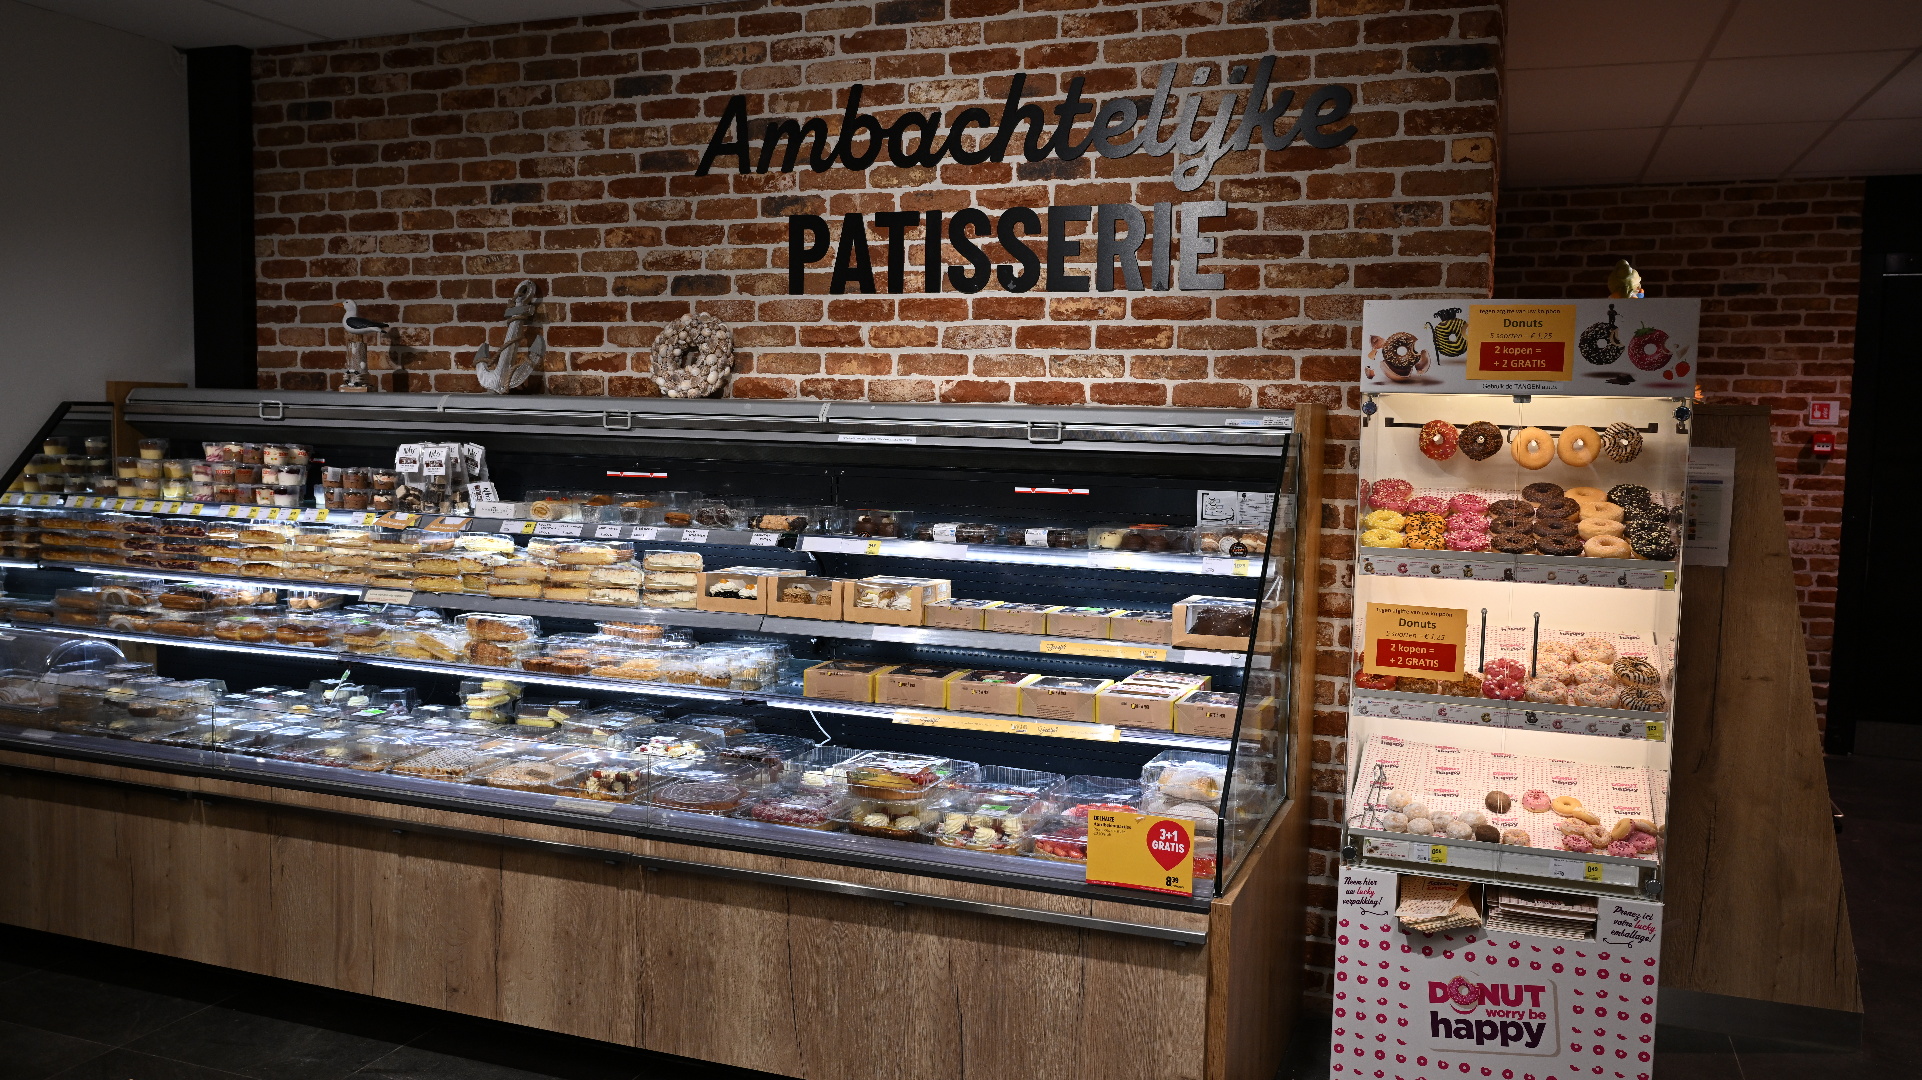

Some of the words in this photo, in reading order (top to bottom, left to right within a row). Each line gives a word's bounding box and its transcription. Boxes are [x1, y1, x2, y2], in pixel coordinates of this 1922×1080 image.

[695, 55, 1357, 193] Ambachtelijke
[788, 201, 1228, 295] PATISSERIE
[1503, 318, 1543, 328] Donuts
[1494, 345, 1501, 354] 2
[1503, 345, 1533, 356] kopen
[1502, 359, 1508, 368] 2
[1510, 359, 1546, 368] GRATIS
[1398, 617, 1437, 629] Donuts
[1390, 644, 1396, 652] 2
[1398, 644, 1427, 655] kopen
[1397, 656, 1403, 665] 2
[1405, 657, 1439, 668] GRATIS
[1159, 828, 1178, 842] 3+1
[1151, 840, 1185, 853] GRATIS
[1343, 876, 1362, 885] Neem
[1362, 877, 1378, 886] hier
[1356, 886, 1376, 898] lucky
[1612, 905, 1642, 921] Prenez
[1642, 912, 1654, 921] ici
[1613, 919, 1633, 928] votre
[1633, 919, 1657, 935] lucky
[1428, 977, 1546, 1008] DONUT
[1485, 1008, 1526, 1021] worry
[1528, 1008, 1547, 1021] be
[1429, 1010, 1547, 1048] happy
